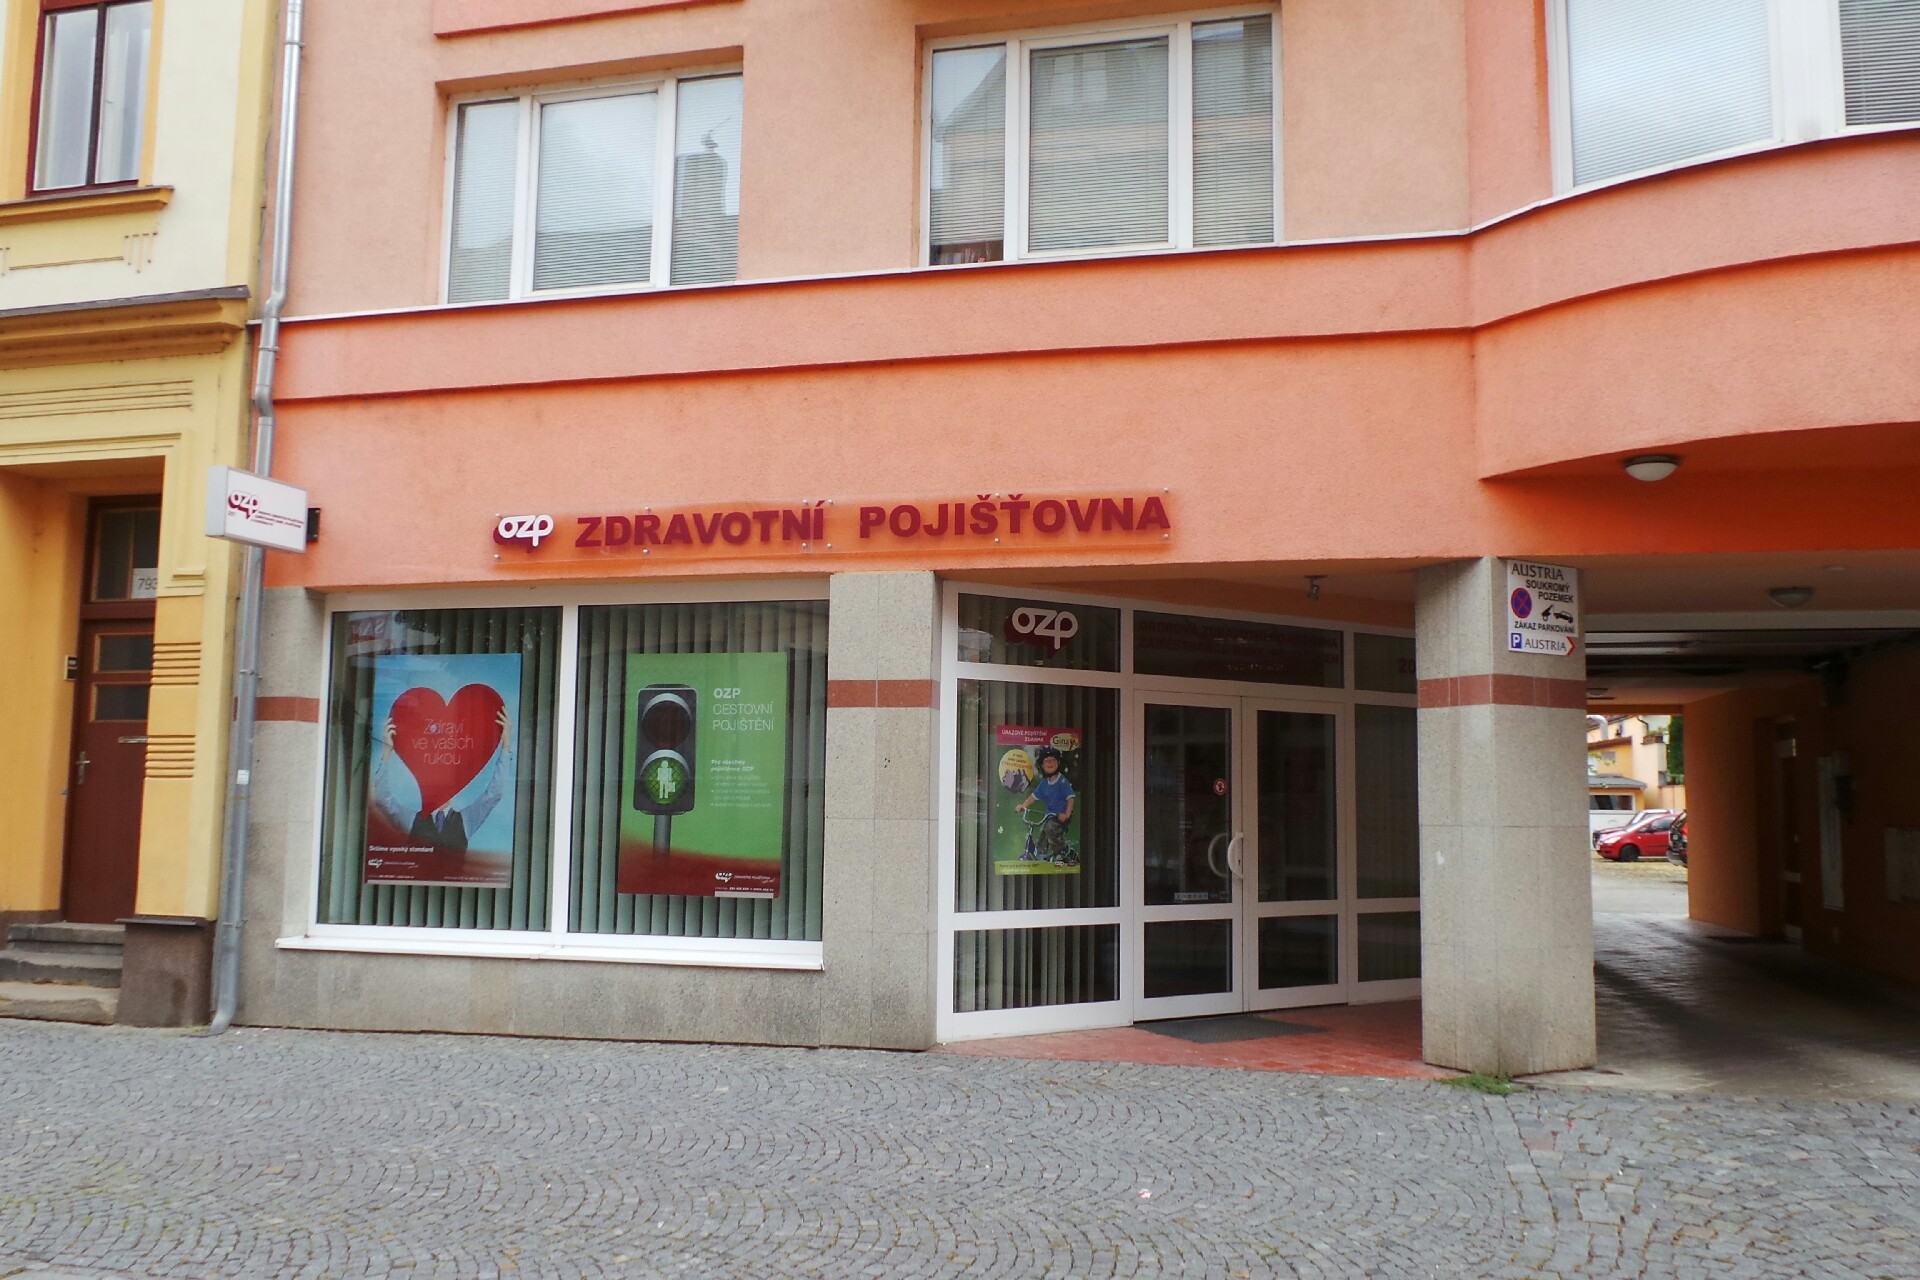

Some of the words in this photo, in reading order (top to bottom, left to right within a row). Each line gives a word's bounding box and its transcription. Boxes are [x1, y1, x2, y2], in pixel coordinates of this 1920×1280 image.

[575, 500, 826, 548] ZDRAVOTNÍ
[859, 494, 1171, 539] POJIŠŤOVNA
[1511, 563, 1564, 580] AUSTRIA
[1525, 580, 1570, 593] SOUKROMÝ
[1538, 591, 1574, 603] POZEMEK
[1524, 638, 1567, 652] AUSTRIA
[713, 688, 741, 699] OZP
[713, 701, 774, 715] CESTOVNÍ
[712, 718, 775, 731] POJIŠTĚNÍ
[411, 737, 428, 750] ve
[432, 735, 474, 750] vašich
[423, 750, 461, 765] rukou
